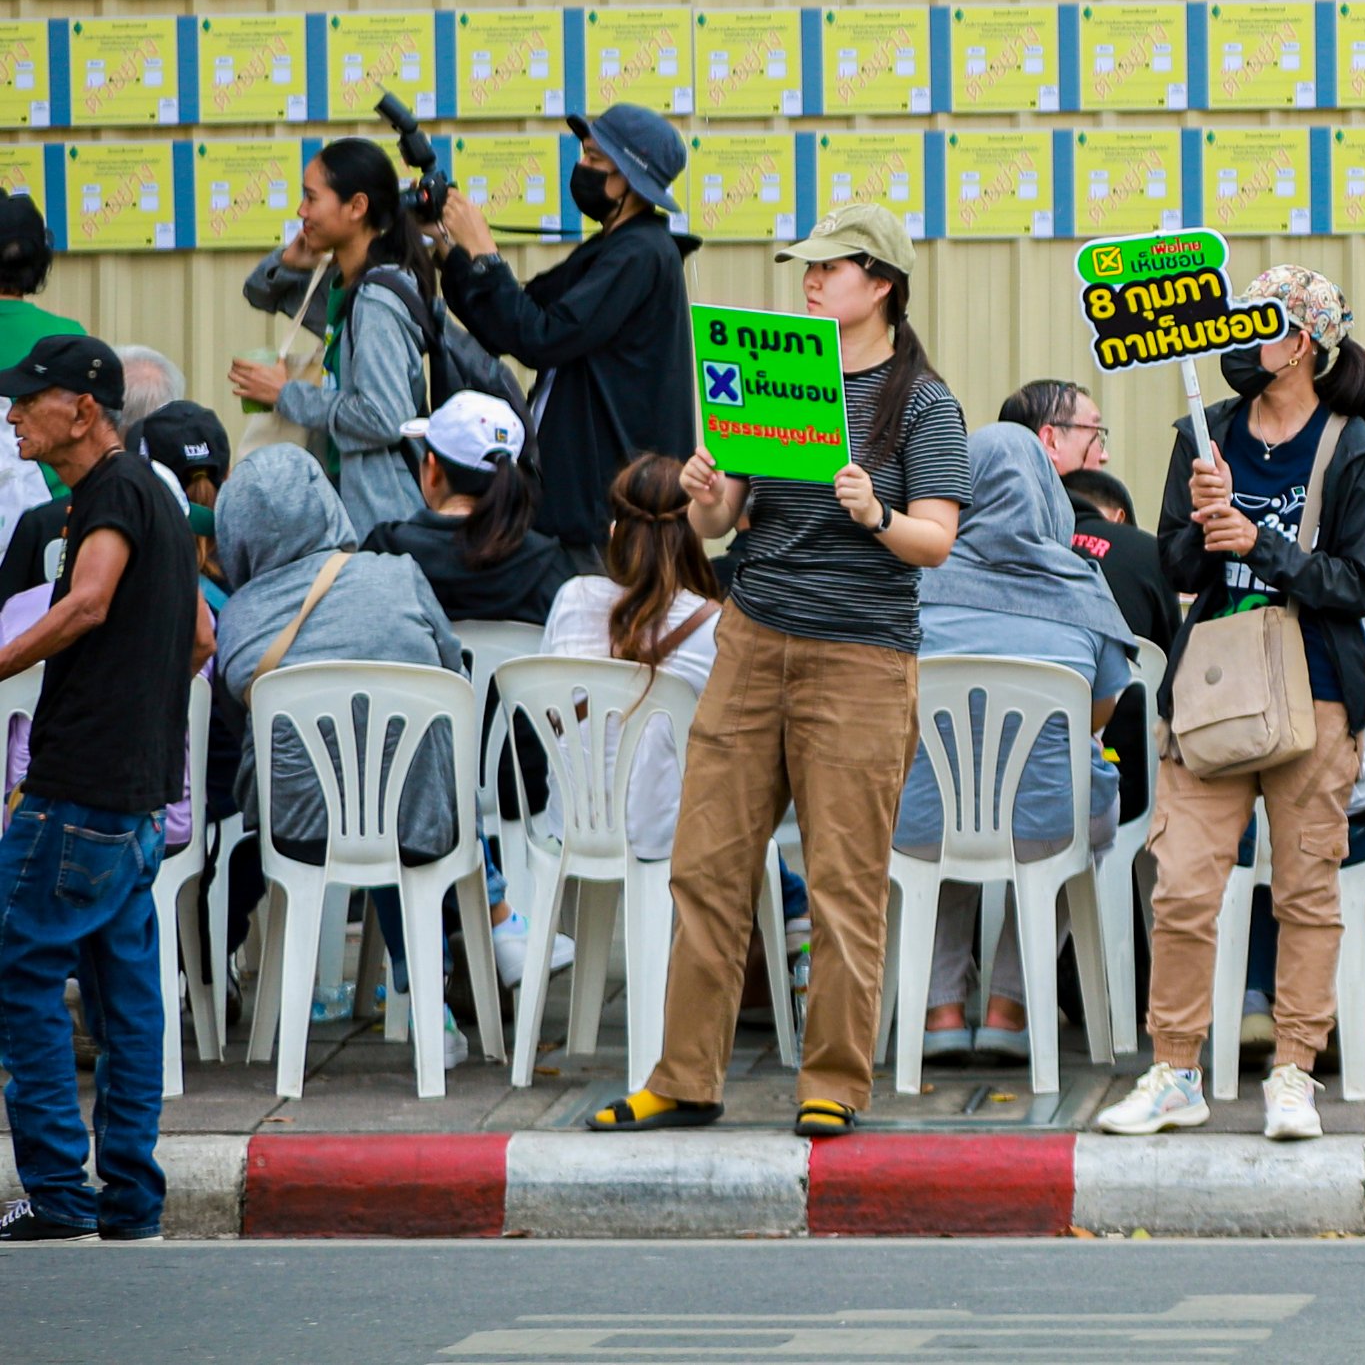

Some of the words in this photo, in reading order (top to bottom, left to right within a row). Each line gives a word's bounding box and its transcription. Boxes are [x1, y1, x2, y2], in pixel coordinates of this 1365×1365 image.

[1151, 235, 1202, 255] เพื่อไทย
[1131, 250, 1206, 274] เห็นชอบ
[1089, 289, 1116, 319] 8
[1124, 272, 1221, 321] กุมภา
[709, 320, 728, 347] 8
[736, 325, 823, 360] กุมภา
[1100, 306, 1279, 366] กาเห็นชอบ
[745, 371, 838, 404] เห็นชอบ
[708, 414, 842, 446] รัฐธรรมนูญใหม่
